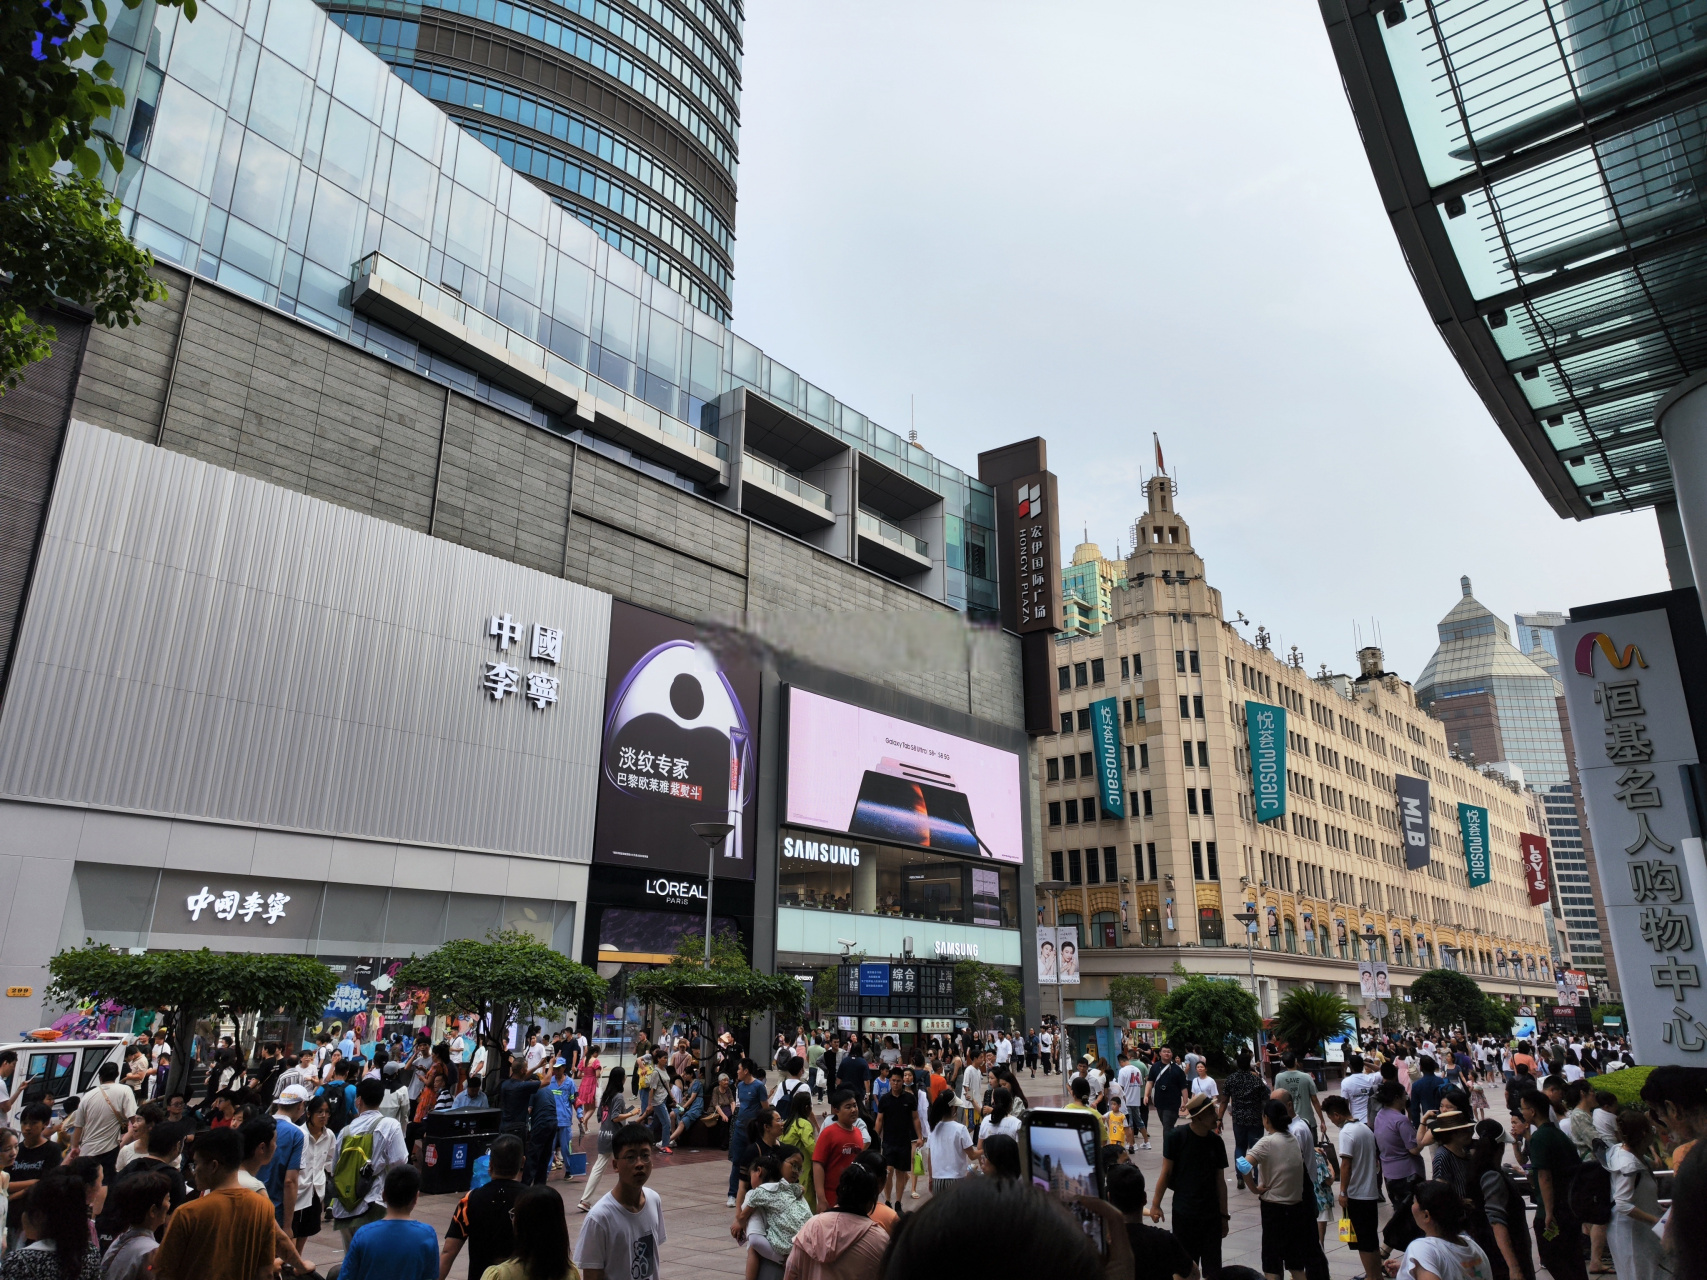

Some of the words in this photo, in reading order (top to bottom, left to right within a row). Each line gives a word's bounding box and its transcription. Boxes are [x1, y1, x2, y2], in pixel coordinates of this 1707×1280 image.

[1019, 528, 1028, 578] HONGYI
[1030, 525, 1046, 619] 宏伊国际广场
[1022, 582, 1030, 624] PLAZA
[490, 612, 564, 664] 中國
[484, 662, 560, 709] 李寧
[885, 738, 902, 748] Galaxy
[902, 742, 910, 750] Tab
[618, 746, 690, 780] 淡纹专家
[616, 772, 701, 800] 巴黎欧莱雅紫熨斗
[1402, 796, 1426, 847] MLB
[784, 837, 860, 866] SAMSUNG
[1594, 679, 1707, 1052] 恒基名人购物中心
[646, 878, 708, 899] L'ORÉAL
[934, 940, 978, 956] SAMSUNG
[892, 968, 915, 980] 综合
[892, 981, 915, 993] 服务
[939, 970, 952, 982] 上海
[939, 983, 952, 994] 经典
